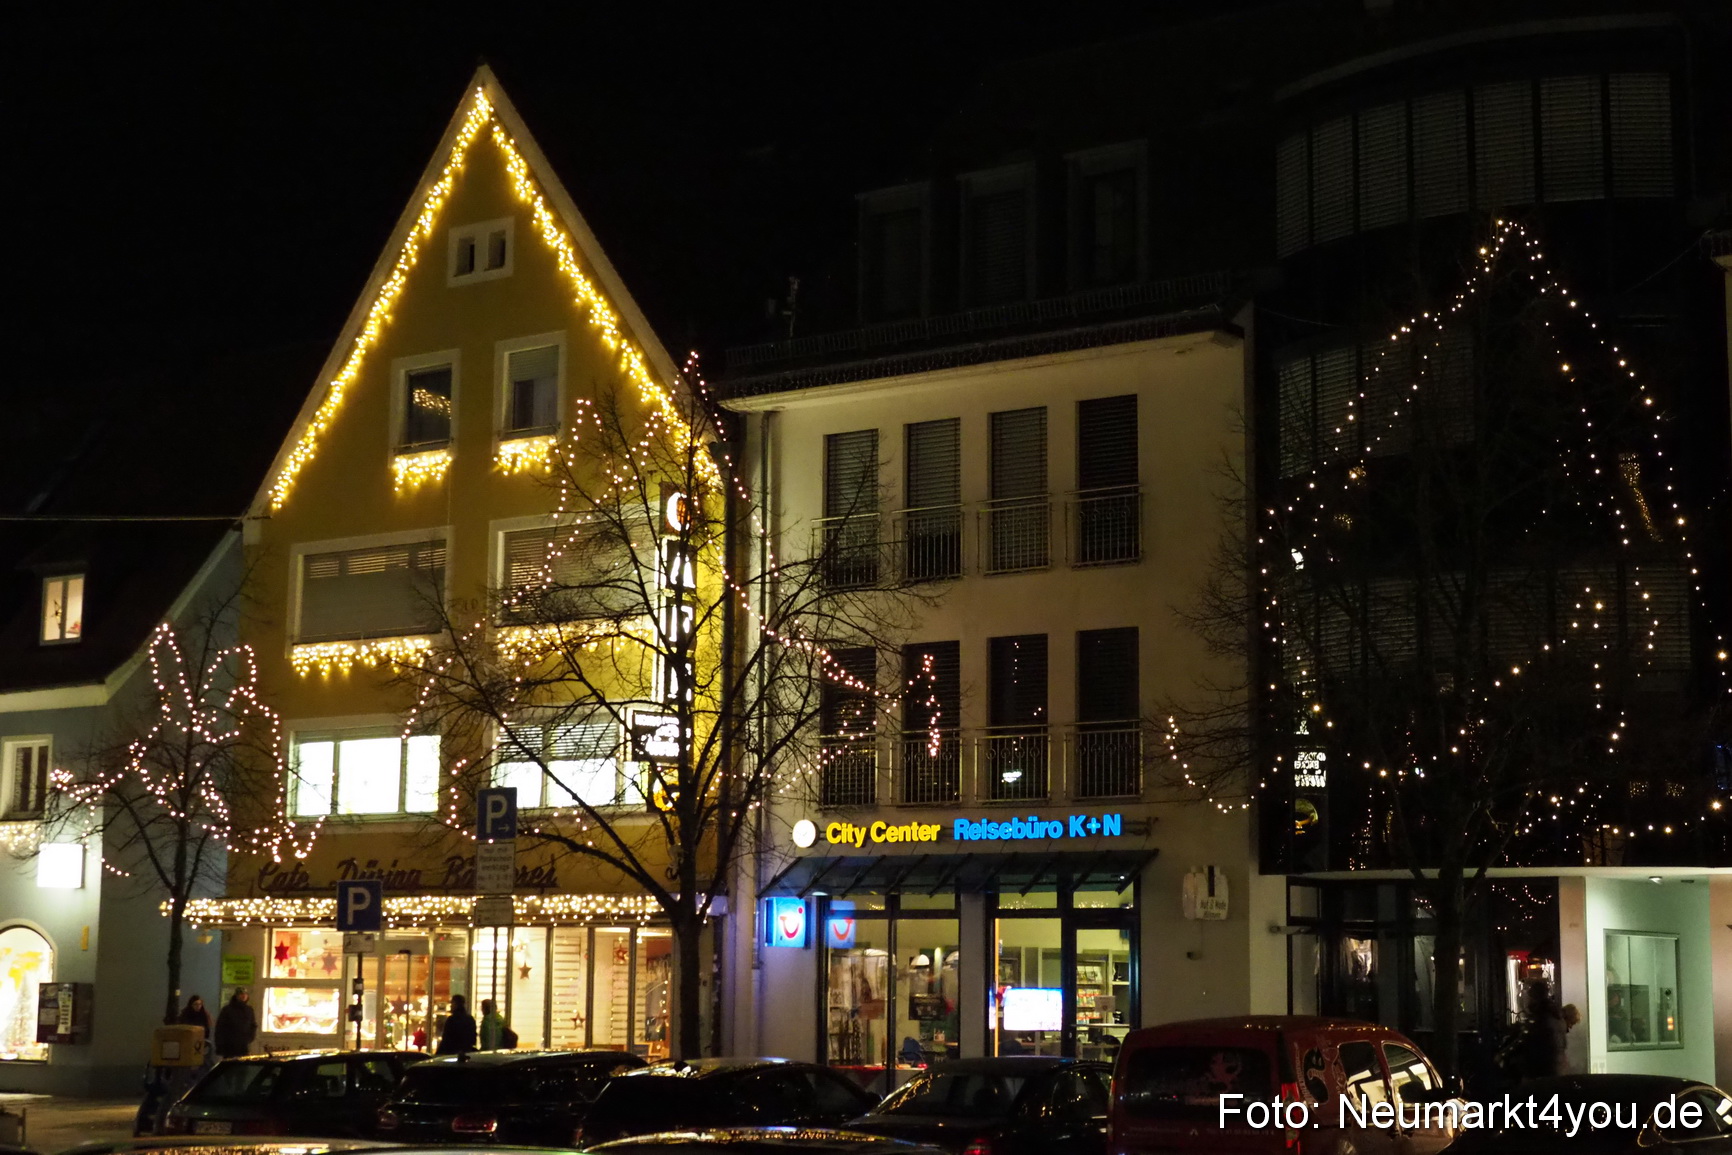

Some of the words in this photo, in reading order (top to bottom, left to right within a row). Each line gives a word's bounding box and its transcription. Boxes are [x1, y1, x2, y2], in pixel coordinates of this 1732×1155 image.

[486, 795, 508, 833] P
[826, 822, 866, 848] City
[870, 820, 941, 844] Center
[954, 817, 1063, 841] Reisebüro
[1069, 814, 1121, 837] K+N
[347, 887, 371, 925] P
